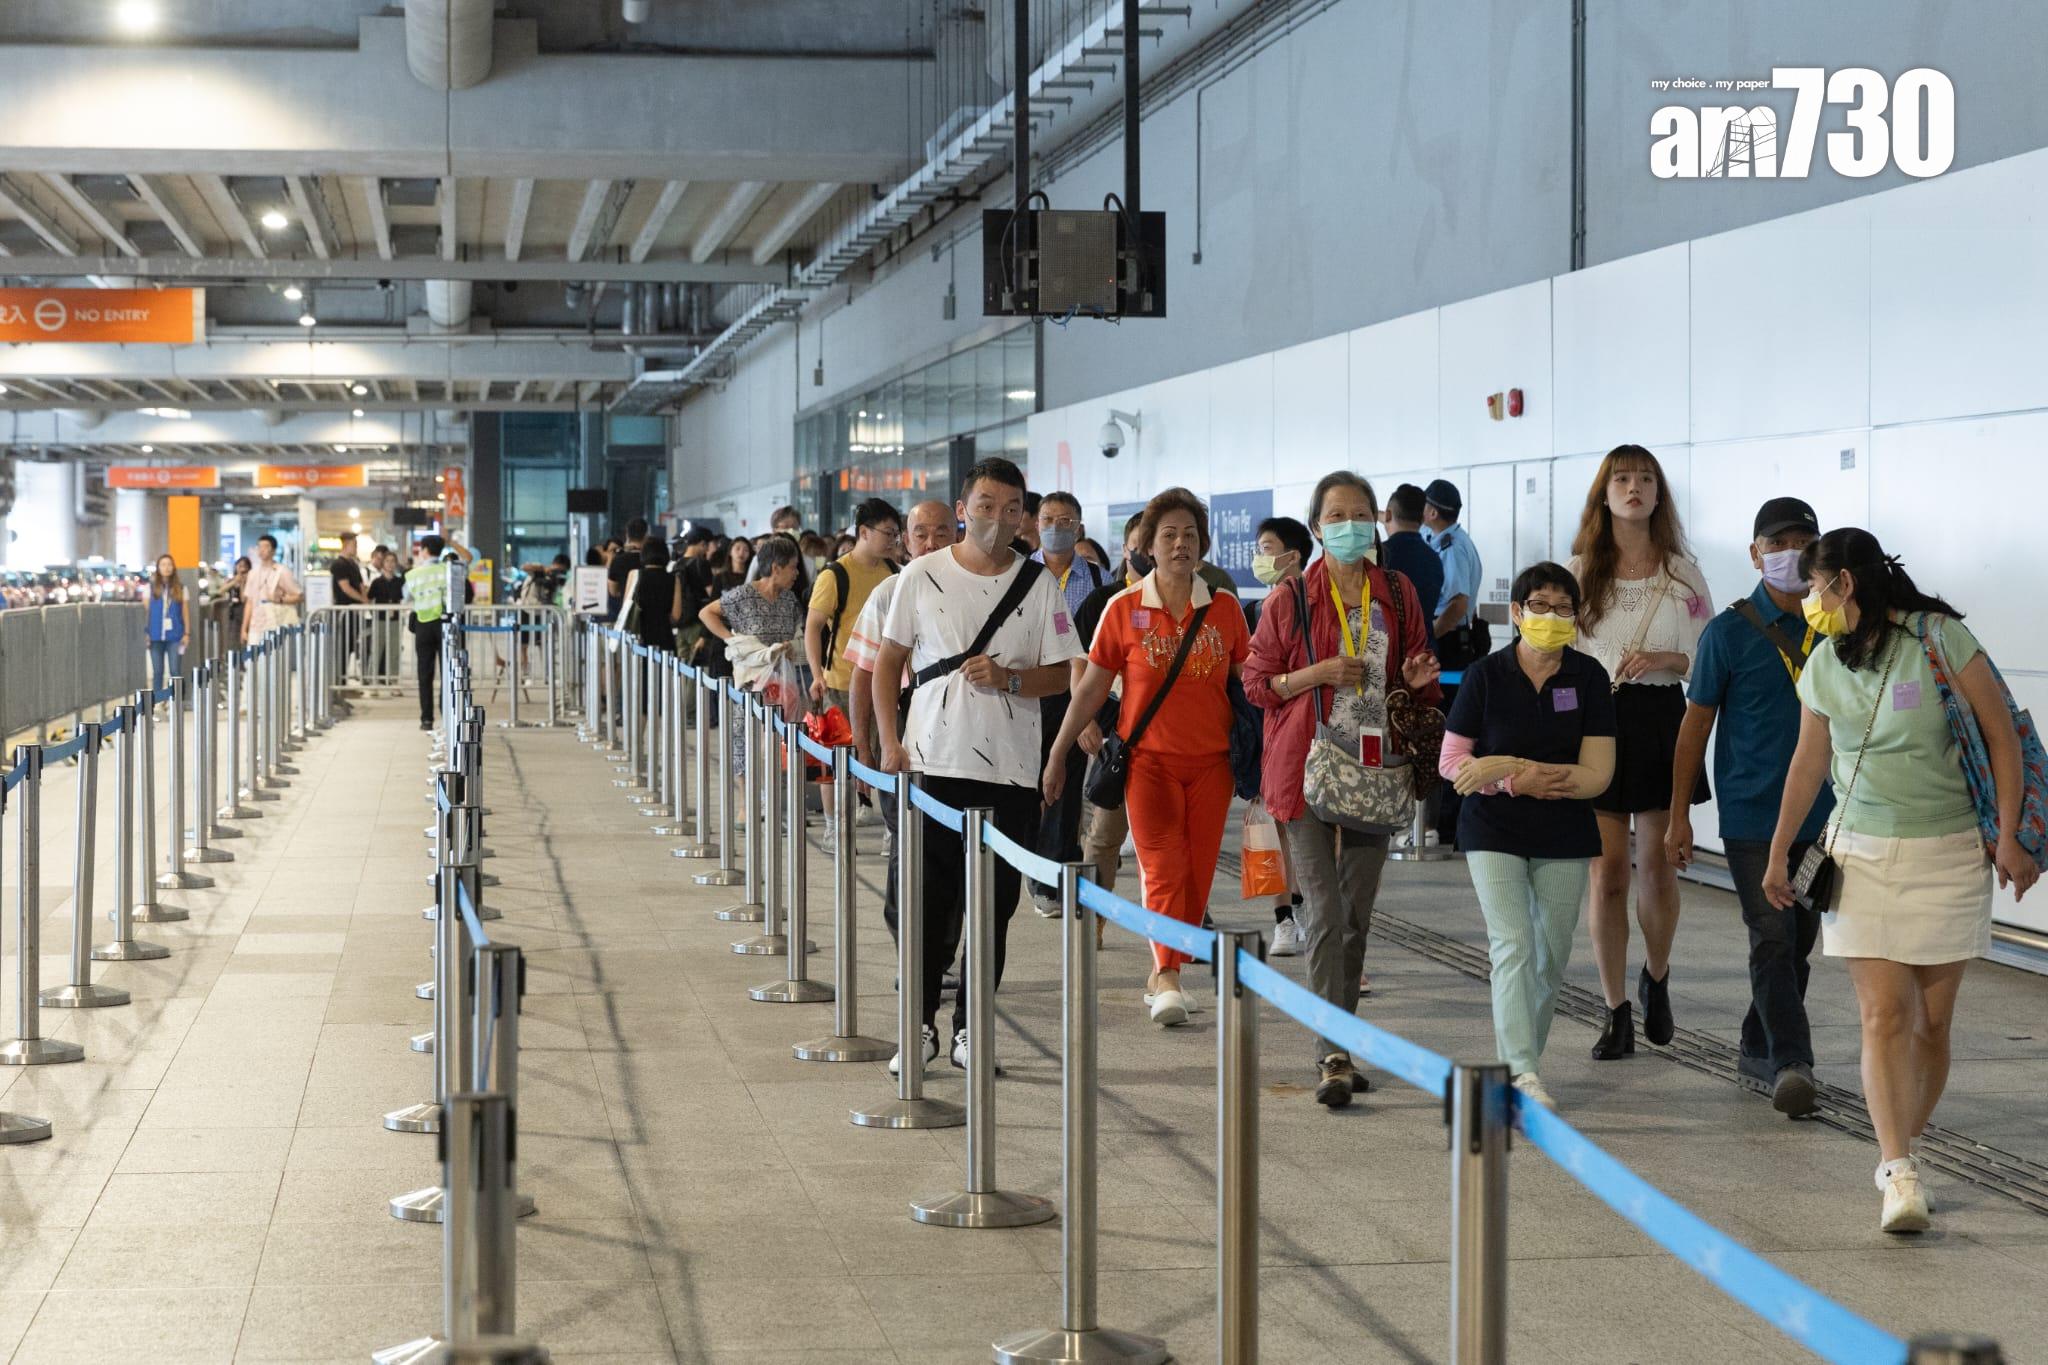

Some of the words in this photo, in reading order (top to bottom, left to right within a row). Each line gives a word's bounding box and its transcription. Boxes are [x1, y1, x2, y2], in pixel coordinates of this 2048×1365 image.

[74, 308, 100, 323] NO
[104, 308, 150, 322] ENTRY
[447, 491, 464, 513] A
